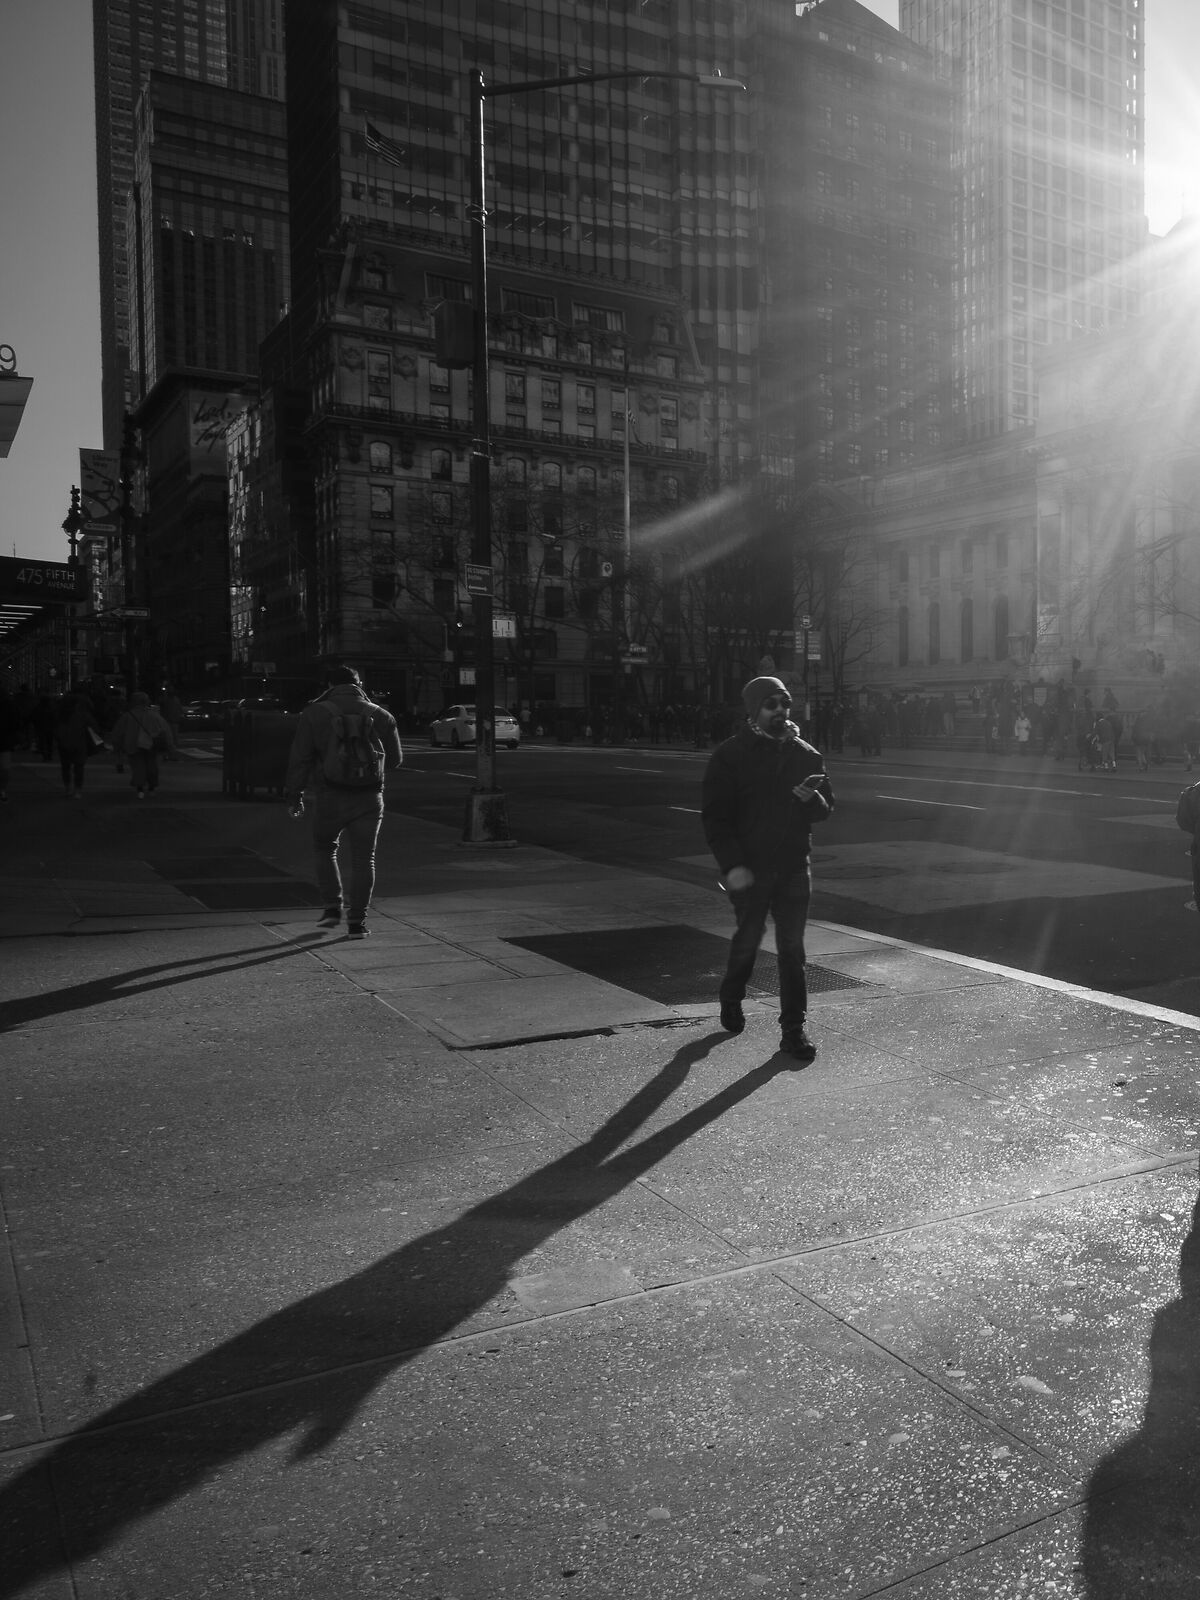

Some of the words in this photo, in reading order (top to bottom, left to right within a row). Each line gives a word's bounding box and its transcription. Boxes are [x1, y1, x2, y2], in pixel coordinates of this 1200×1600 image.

[16, 567, 44, 585] 475
[46, 568, 76, 581] FIFTH
[47, 580, 77, 590] AVENUE
